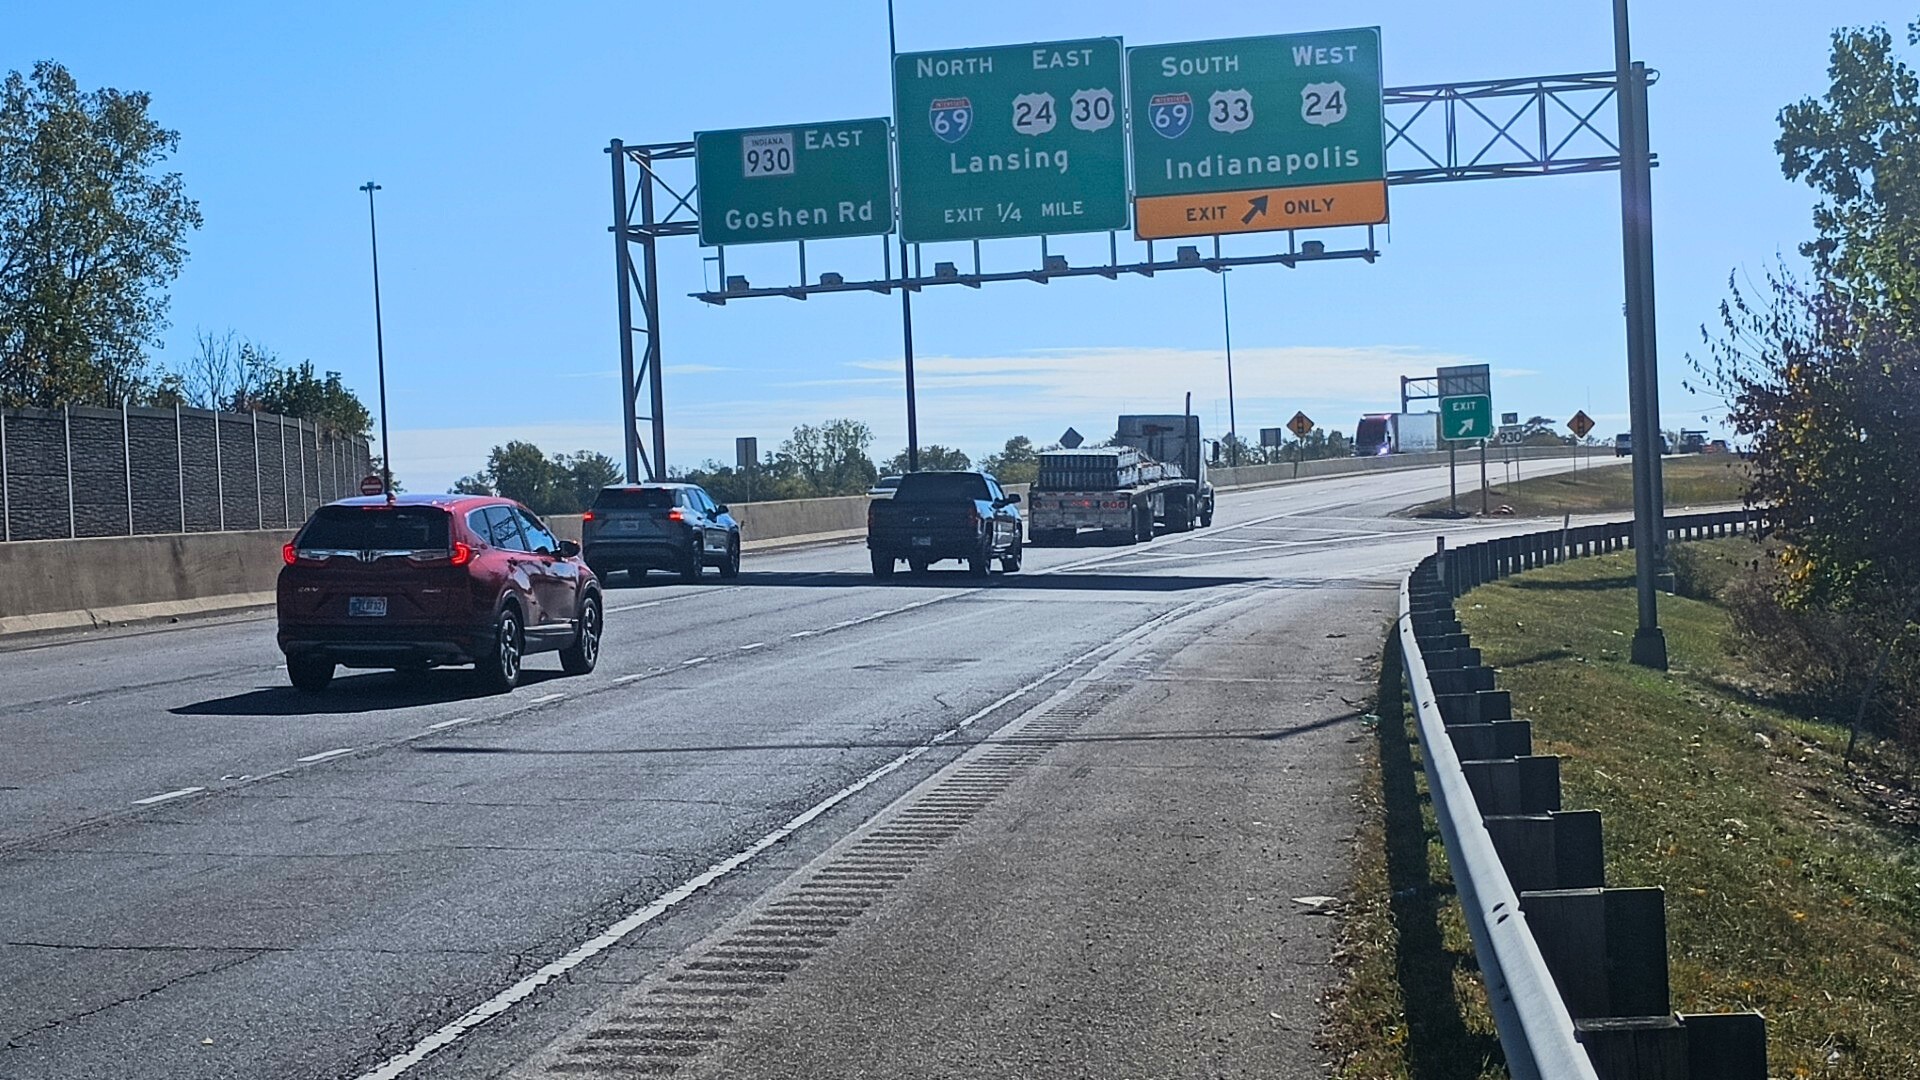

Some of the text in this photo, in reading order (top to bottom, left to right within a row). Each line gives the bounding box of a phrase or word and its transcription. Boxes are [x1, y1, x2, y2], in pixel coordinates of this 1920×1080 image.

[917, 49, 1093, 78] NORTH EAST
[1161, 45, 1358, 77] SOUTH WEST
[1016, 100, 1052, 126] 24
[1075, 97, 1110, 122] 30
[1213, 98, 1249, 123] 33
[1305, 90, 1343, 116] 24
[934, 109, 968, 134] 69
[1155, 104, 1187, 128] 69
[751, 137, 785, 146] INDIANA
[804, 130, 863, 150] EAST
[747, 148, 791, 173] 930
[950, 148, 1069, 174] Lansing
[1165, 146, 1359, 180] Indianapolis
[725, 200, 873, 230] Goshen Rd
[944, 208, 984, 223] EXIT
[1041, 201, 1084, 217] MILE
[1186, 198, 1334, 222] EXIT ONLY
[1452, 401, 1477, 412] EXIT
[1500, 432, 1522, 443] 930
